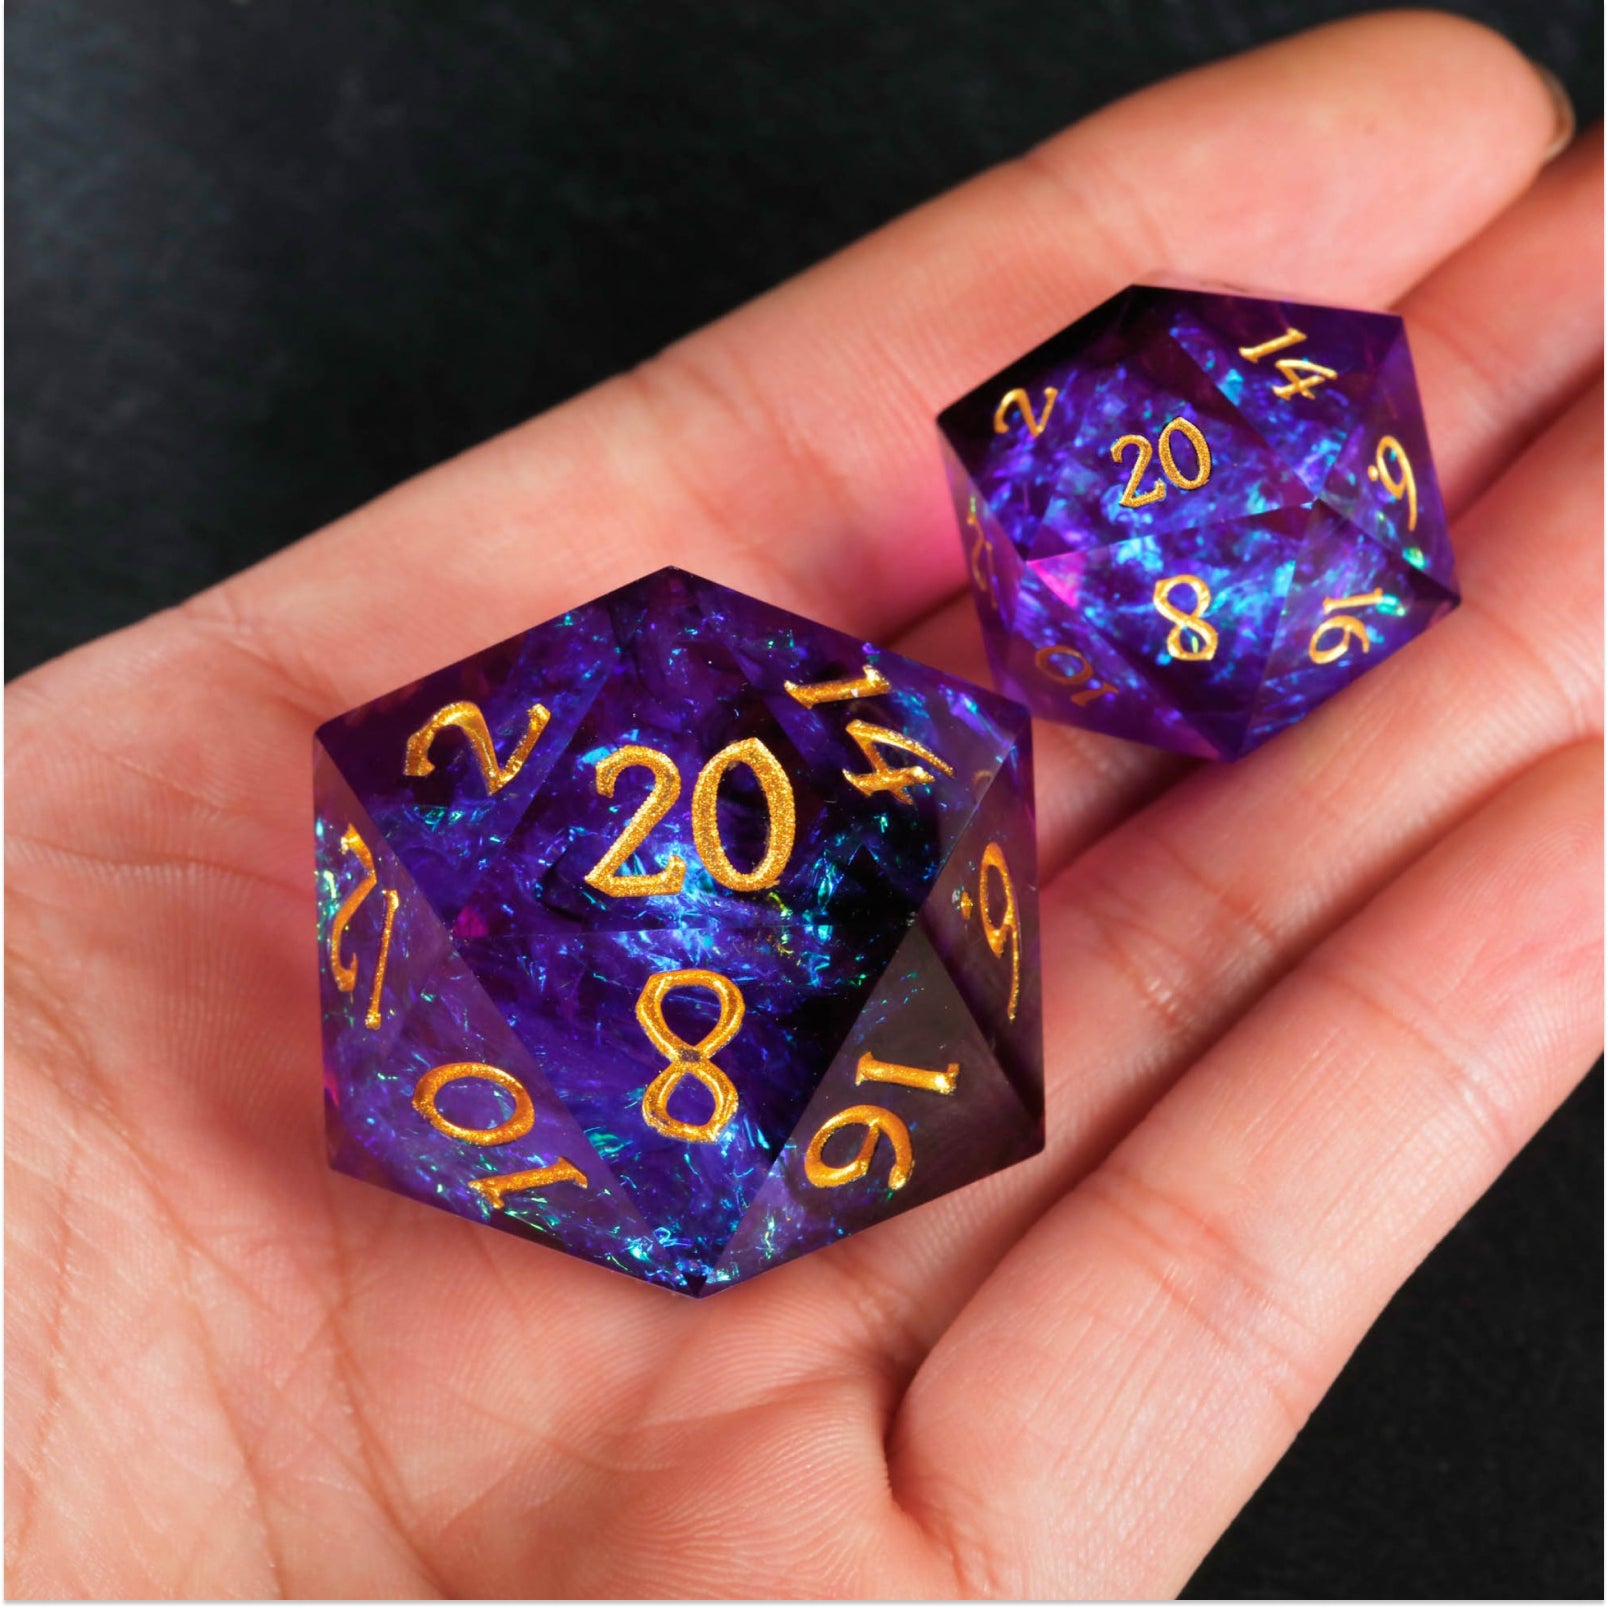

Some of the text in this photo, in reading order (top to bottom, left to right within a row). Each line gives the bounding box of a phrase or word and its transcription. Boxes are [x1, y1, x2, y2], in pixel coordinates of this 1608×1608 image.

[993, 385, 1058, 438] 2
[1238, 327, 1339, 401] 14
[1110, 416, 1212, 508] 20
[1152, 573, 1219, 662] 8
[1308, 587, 1383, 665] 16
[1034, 644, 1120, 707] 10
[403, 700, 552, 796] 2
[784, 665, 956, 805] 14
[584, 738, 797, 899] 20
[331, 822, 400, 1030] 12
[635, 968, 747, 1144] 8
[412, 1062, 589, 1210] 10
[804, 1050, 960, 1191] 16
